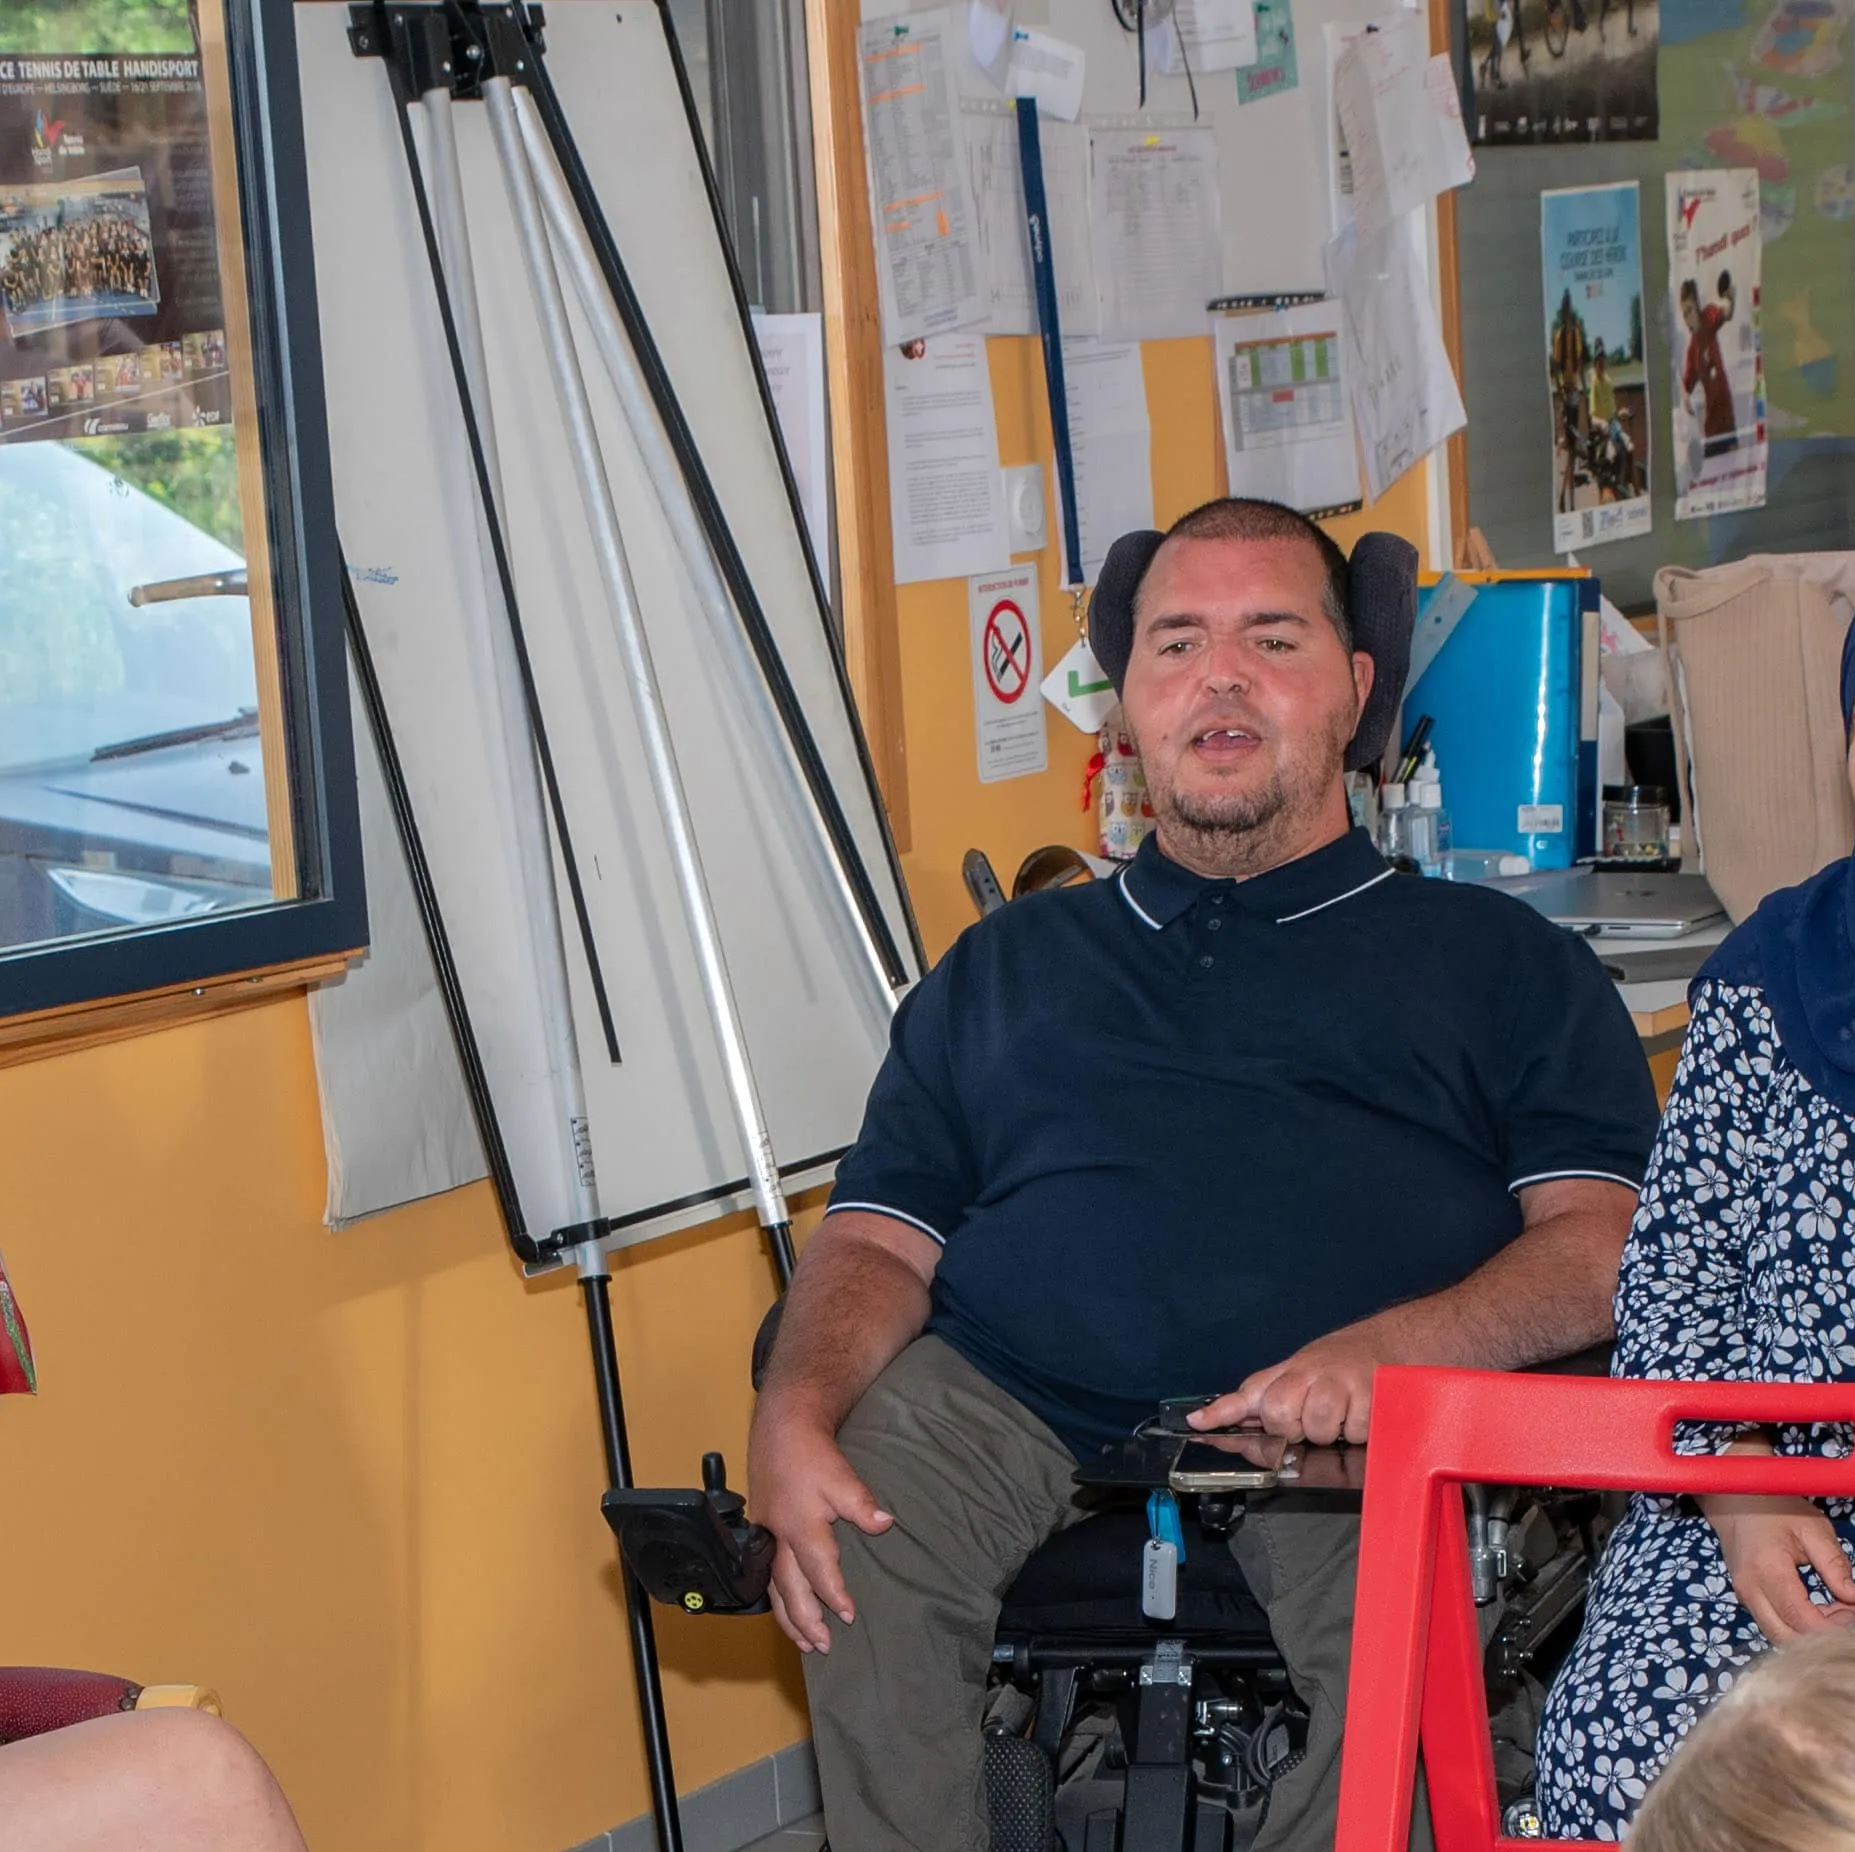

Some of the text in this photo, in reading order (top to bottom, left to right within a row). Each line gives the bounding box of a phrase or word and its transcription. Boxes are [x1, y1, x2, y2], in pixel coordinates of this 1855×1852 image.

[17, 60, 62, 80] TENNIS
[64, 61, 80, 78] DE
[81, 60, 119, 78] TABLE
[124, 59, 199, 78] HANDISPORT
[1148, 1559, 1157, 1590] Nico
